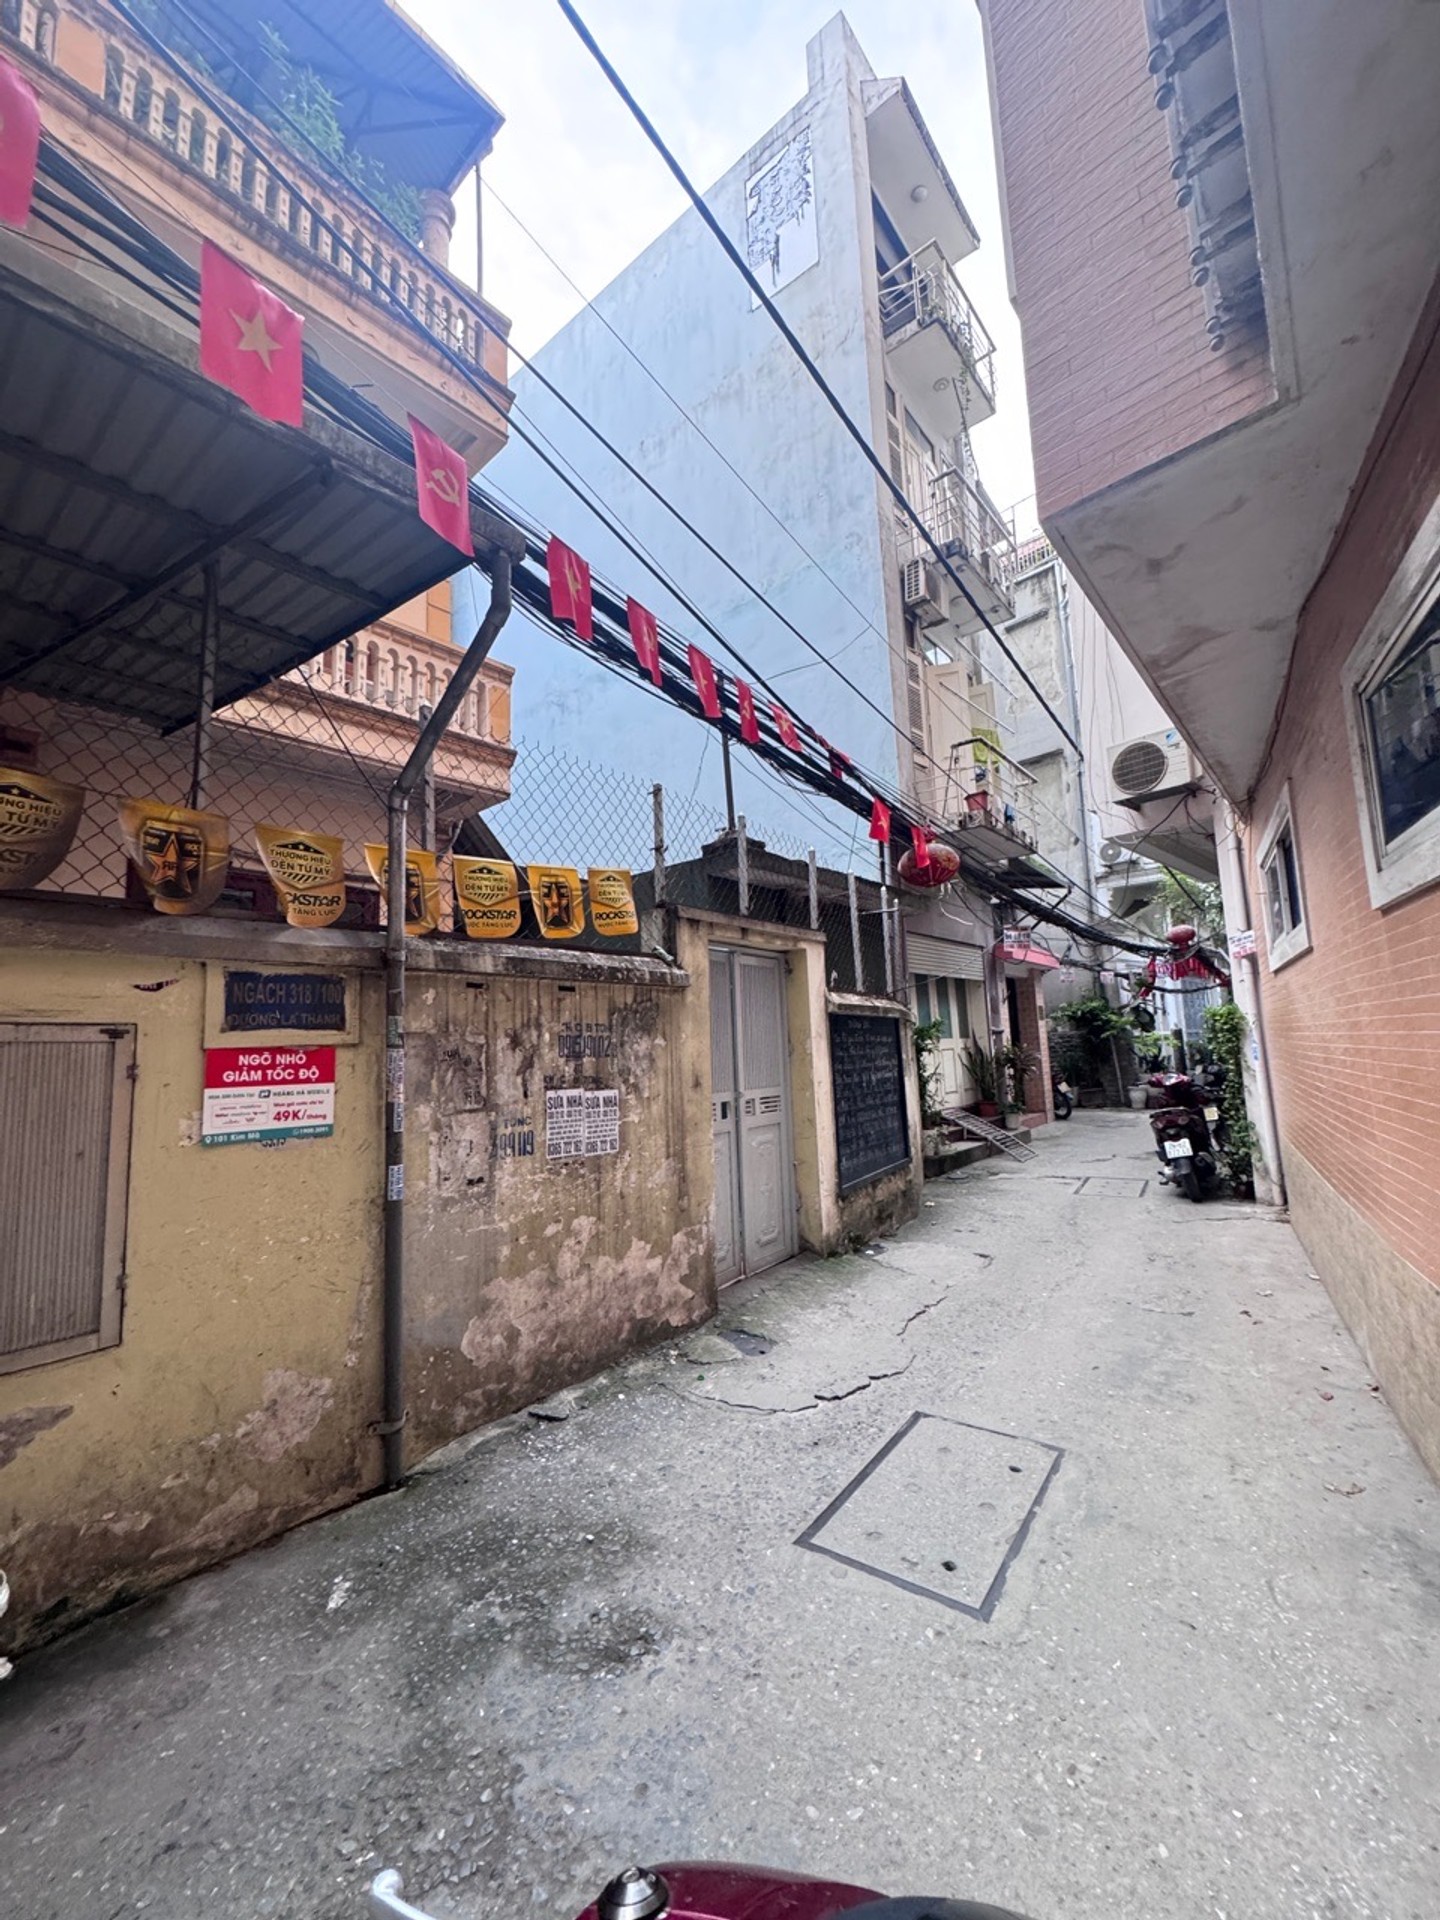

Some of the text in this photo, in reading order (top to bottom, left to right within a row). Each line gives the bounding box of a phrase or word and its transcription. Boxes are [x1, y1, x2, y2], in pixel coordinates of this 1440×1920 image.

[238, 1050, 306, 1066] NGÕ NHỎ
[223, 1065, 320, 1082] GIẢM TỐC ĐỘ
